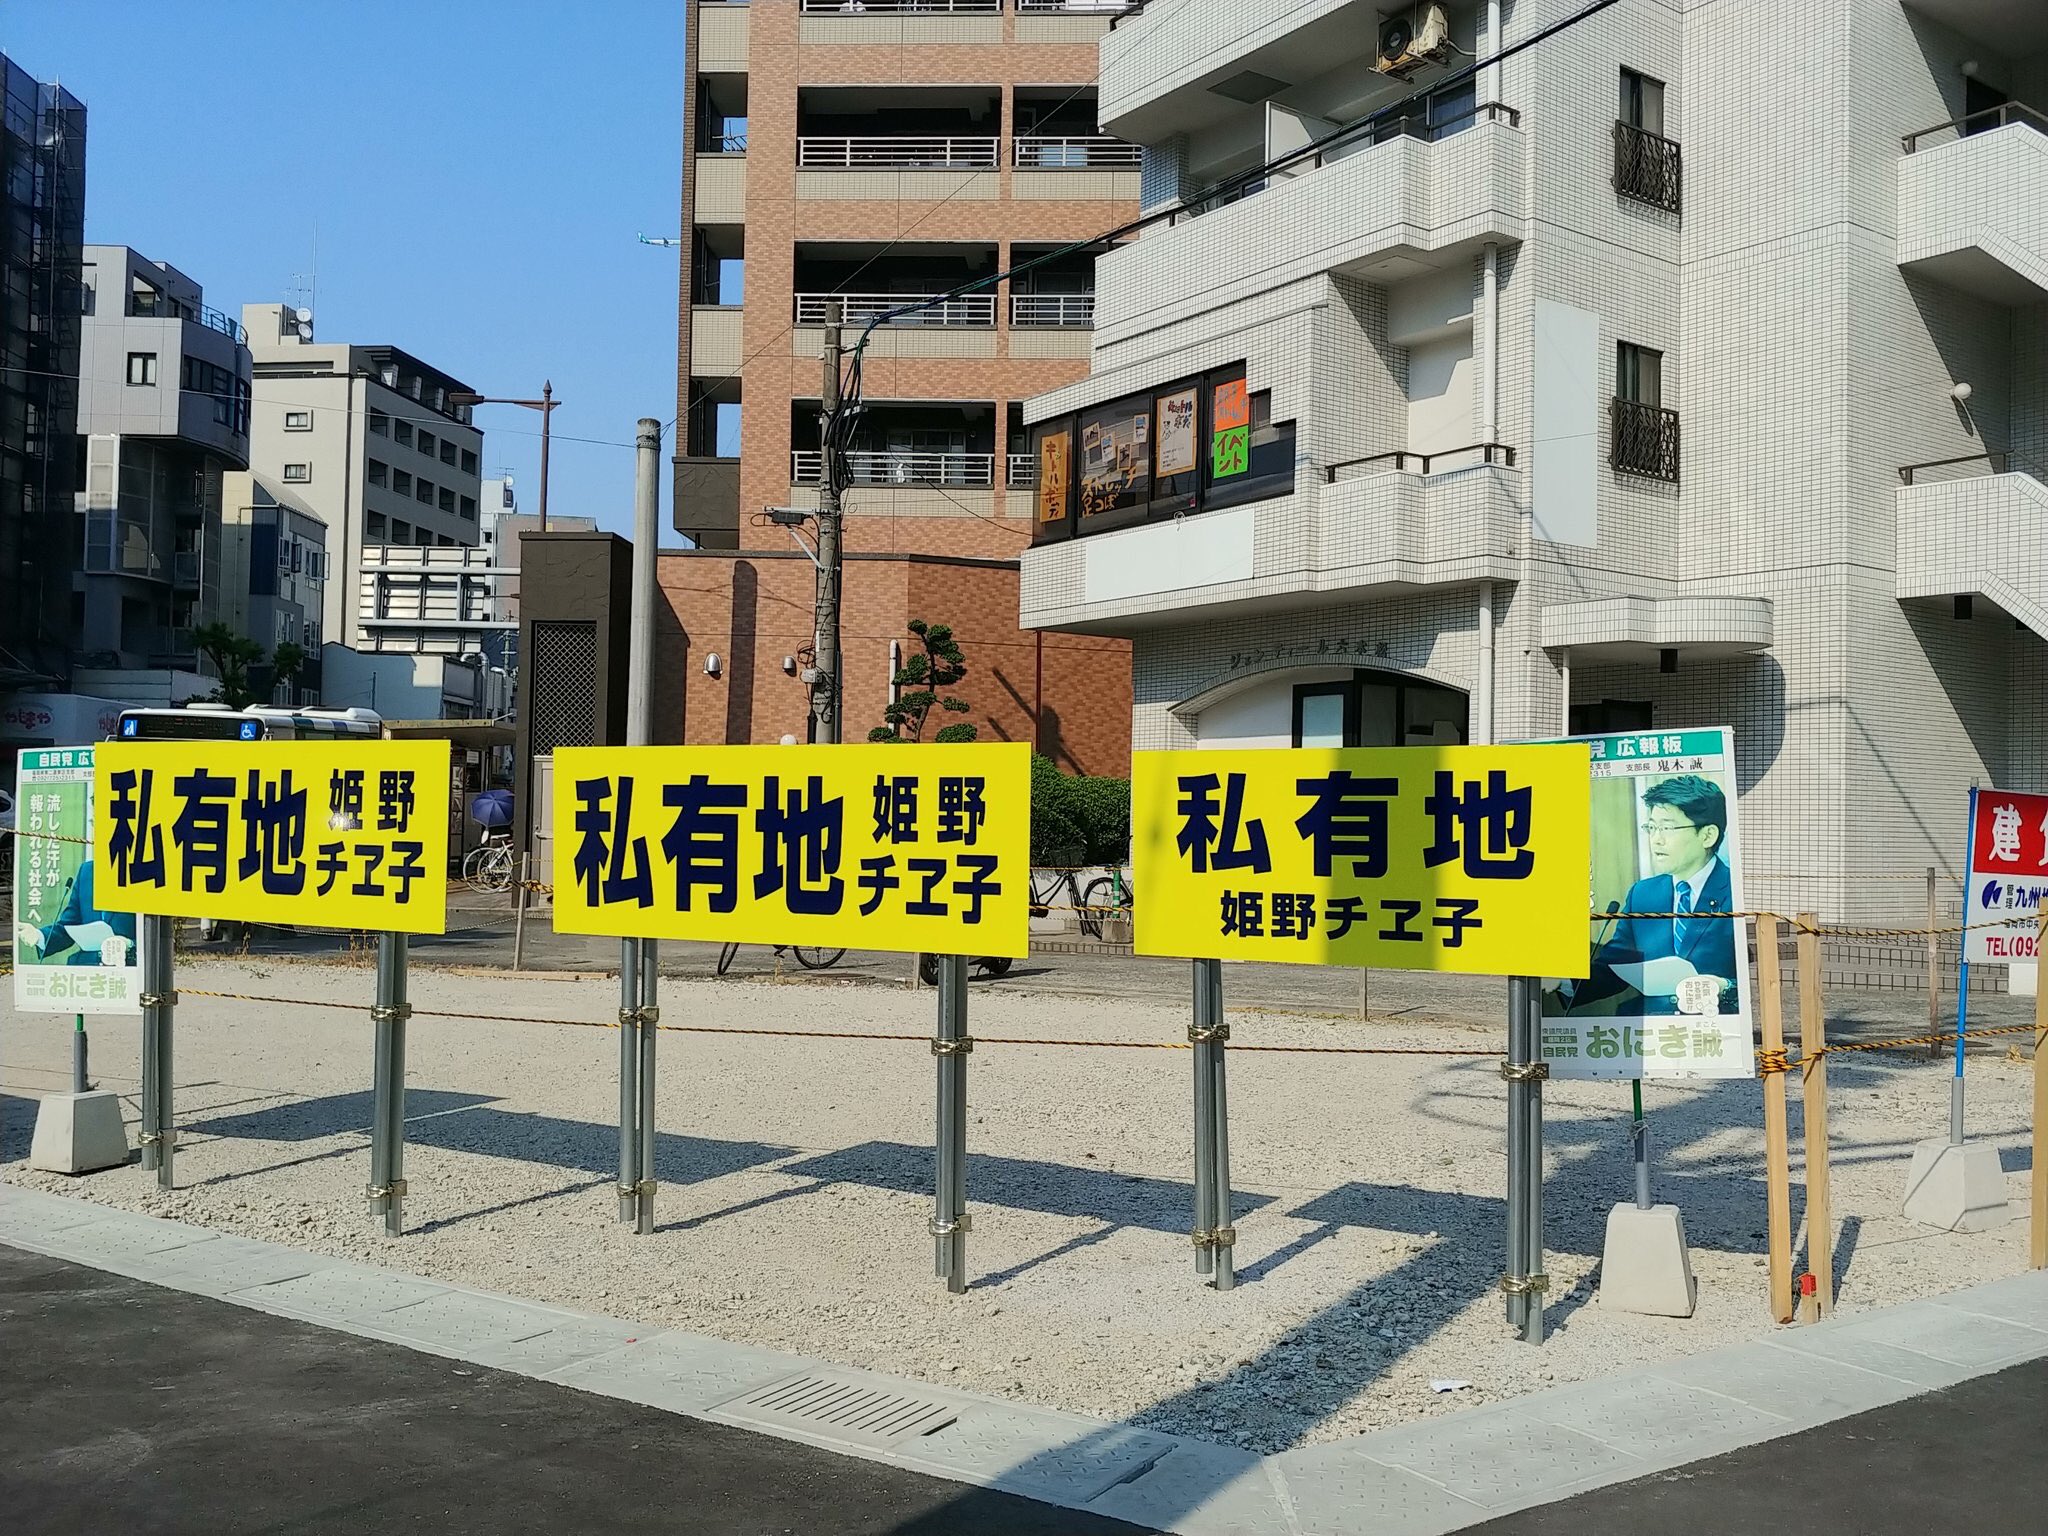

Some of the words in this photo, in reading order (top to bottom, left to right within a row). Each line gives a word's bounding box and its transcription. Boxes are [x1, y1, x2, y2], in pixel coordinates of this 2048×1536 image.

[78, 751, 96, 766] 広
[1616, 735, 1683, 757] 広報板
[108, 768, 307, 896] 私有地
[328, 768, 415, 833] 姫野
[872, 774, 986, 846] 姫野
[1176, 769, 1535, 880] 私有地
[28, 794, 43, 923] 報われる社会へ
[47, 794, 61, 888] 流した汗が
[573, 774, 845, 915] 私有地
[2015, 886, 2048, 909] 九州
[49, 972, 127, 999] おにき誠
[1543, 1046, 1579, 1058] 自民党
[1585, 1024, 1723, 1059] おにき誠
